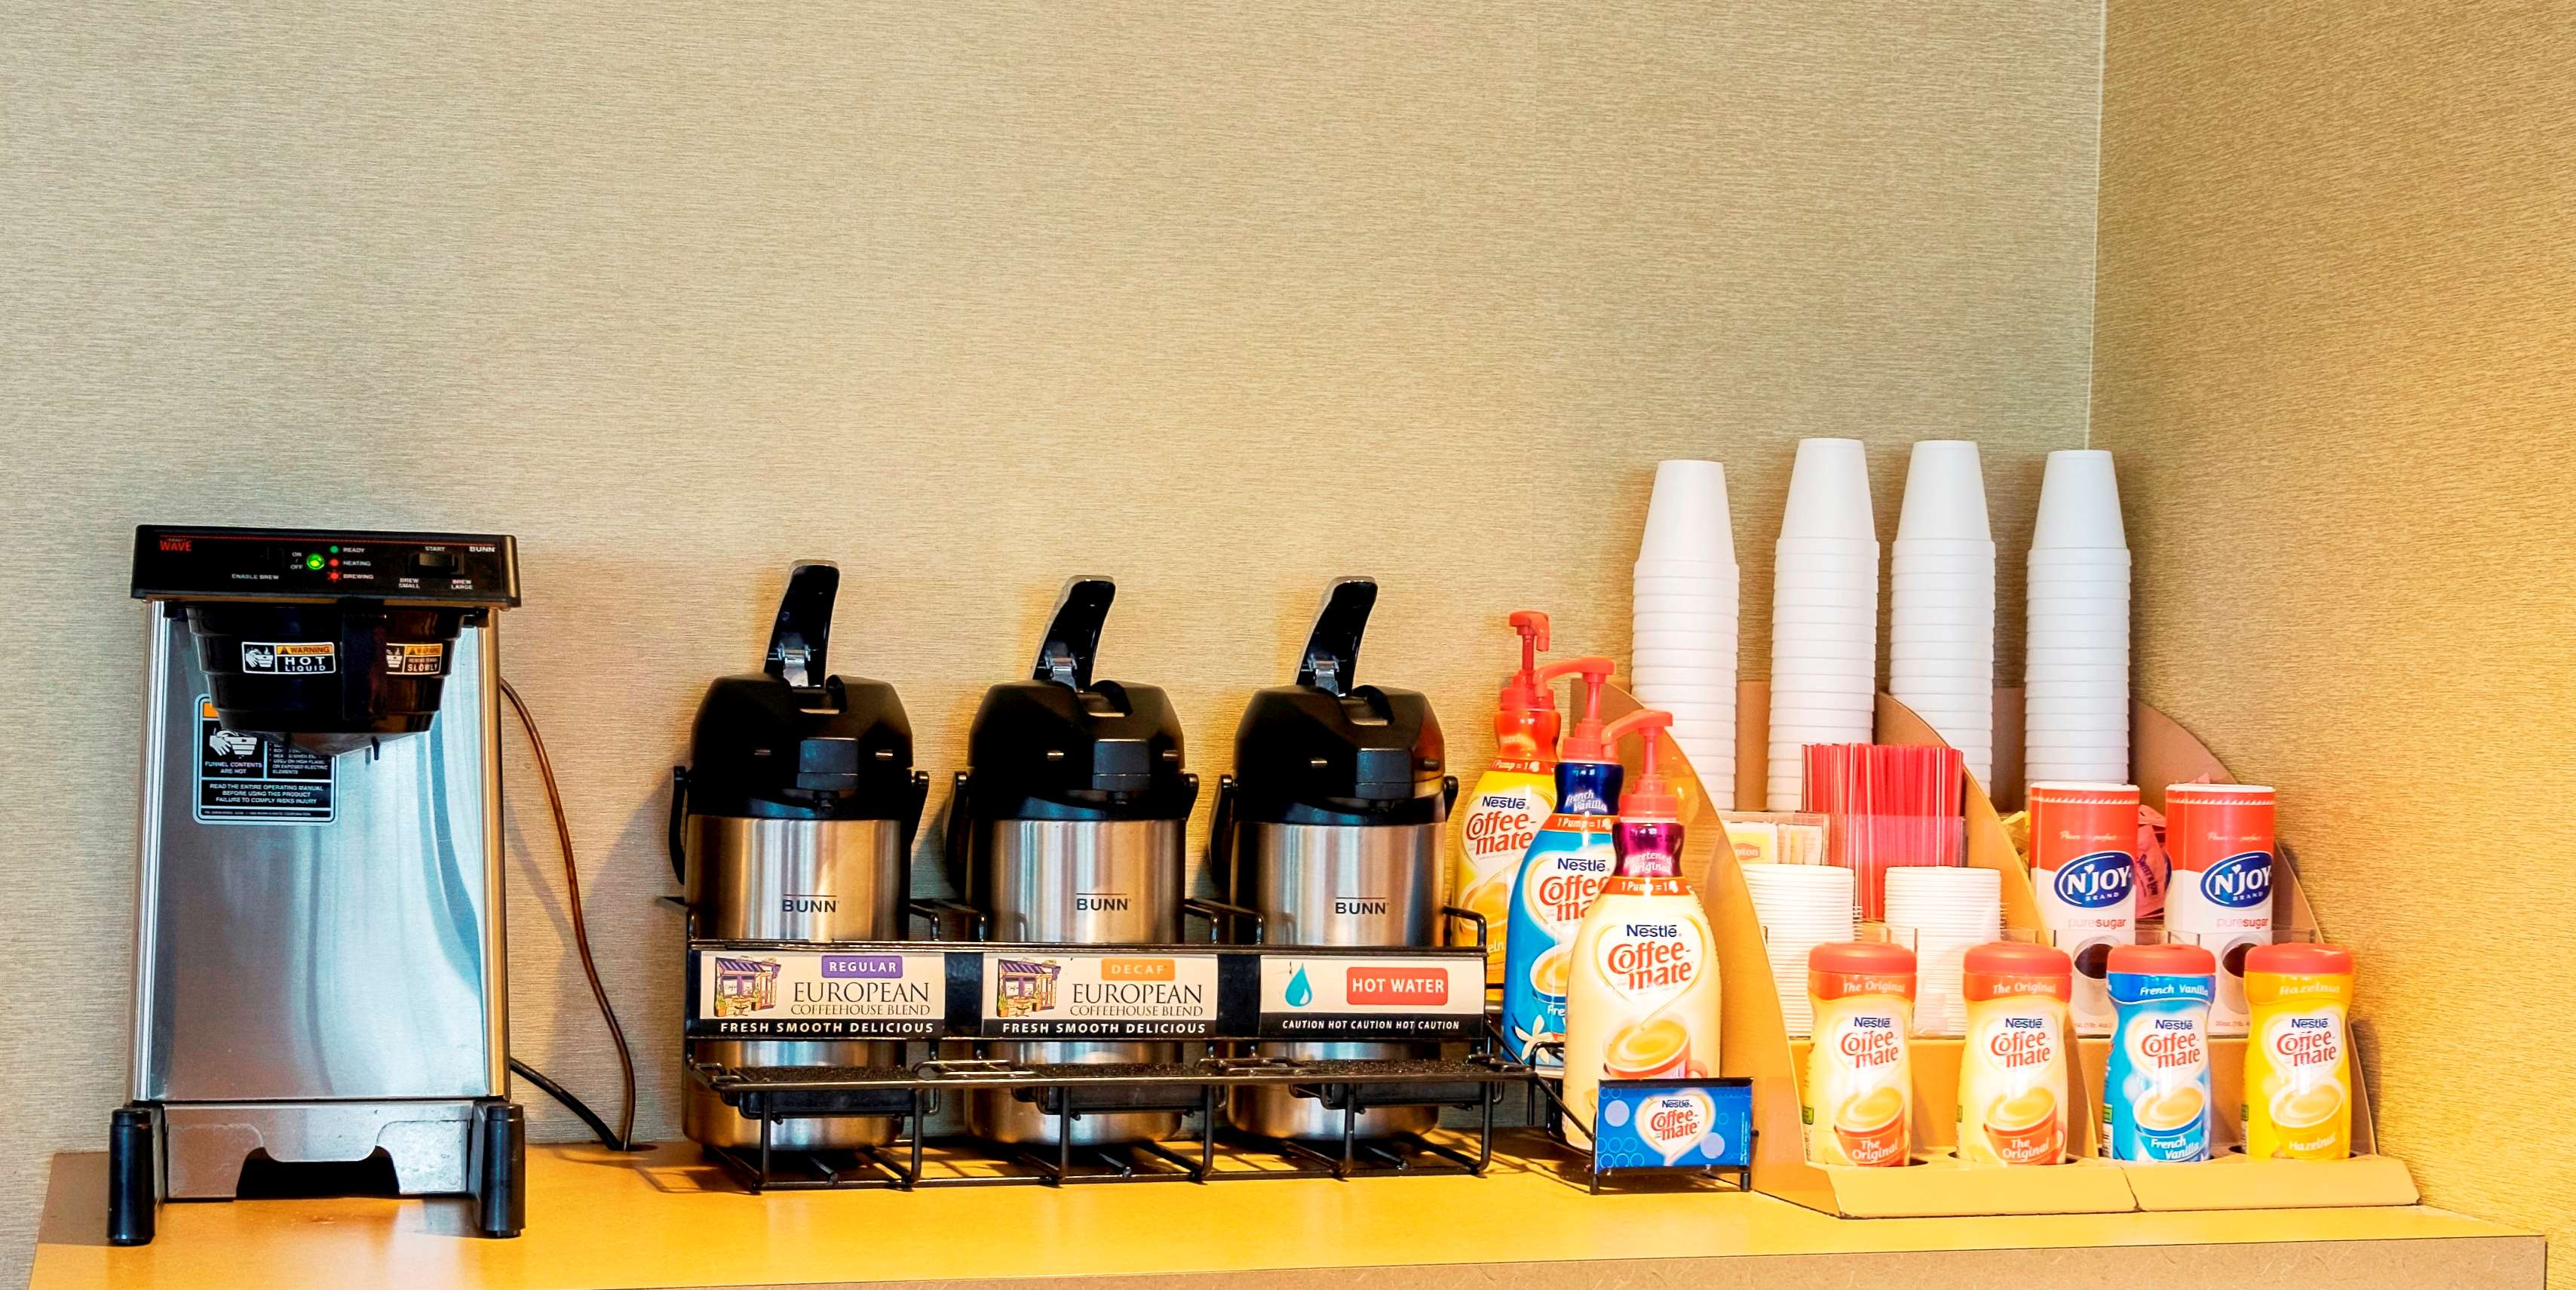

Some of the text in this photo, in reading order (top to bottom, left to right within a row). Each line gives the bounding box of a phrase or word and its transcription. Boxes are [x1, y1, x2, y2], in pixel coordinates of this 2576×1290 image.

[160, 540, 192, 551] WAVE
[285, 656, 326, 665] HOT
[1482, 796, 1526, 809] Nestlé
[1465, 810, 1537, 840] Coffee-
[1562, 818, 1587, 831] Pump
[1475, 831, 1533, 855] mate
[1557, 858, 1605, 872] Nestlé
[2084, 892, 2120, 902] BRAND
[2232, 892, 2263, 902] BRAND
[782, 899, 836, 913] BUNN
[1076, 898, 1128, 911] BUNN
[1335, 902, 1386, 914] BUNN
[1556, 900, 1593, 921] ma
[1627, 924, 1677, 938] Nestlé
[1608, 941, 1691, 975] Coffee-
[829, 961, 897, 972] REGULAR
[1111, 964, 1164, 975] DECAF
[1629, 961, 1691, 991] mate
[793, 981, 929, 1003] EUROPEAN
[1351, 978, 1444, 994] HOT WATER
[1843, 981, 1906, 994] The Original
[1992, 981, 2056, 994] The Original
[2140, 984, 2209, 997] French Vanilla
[2279, 981, 2340, 996] Hazelnut
[1072, 983, 1203, 1004] EUROPEAN
[791, 1004, 931, 1015] COFFEEHOUSE BLEND
[1070, 1005, 1203, 1016] COFFEEHOUSE BLEND
[721, 1022, 934, 1033] FRESH SMOOTH DELICIOUS
[1003, 1023, 1205, 1034] FRESH SMOOTH DELICIOUS
[1282, 1019, 1460, 1030] CAUTION HOT CAUTION HOT CAUTION
[1855, 1046, 1899, 1068] mate
[2006, 1046, 2050, 1068] mate
[2157, 1048, 2200, 1068] mate
[2293, 1046, 2337, 1067] mate
[1661, 1124, 1697, 1141] mate
[1860, 1139, 1880, 1149] The
[2010, 1138, 2030, 1148] The
[2151, 1135, 2187, 1148] French
[2289, 1135, 2336, 1151] Hazelnut
[1851, 1139, 1899, 1162] Original
[2002, 1138, 2050, 1162] Original
[2166, 1141, 2201, 1159] Vanilla
